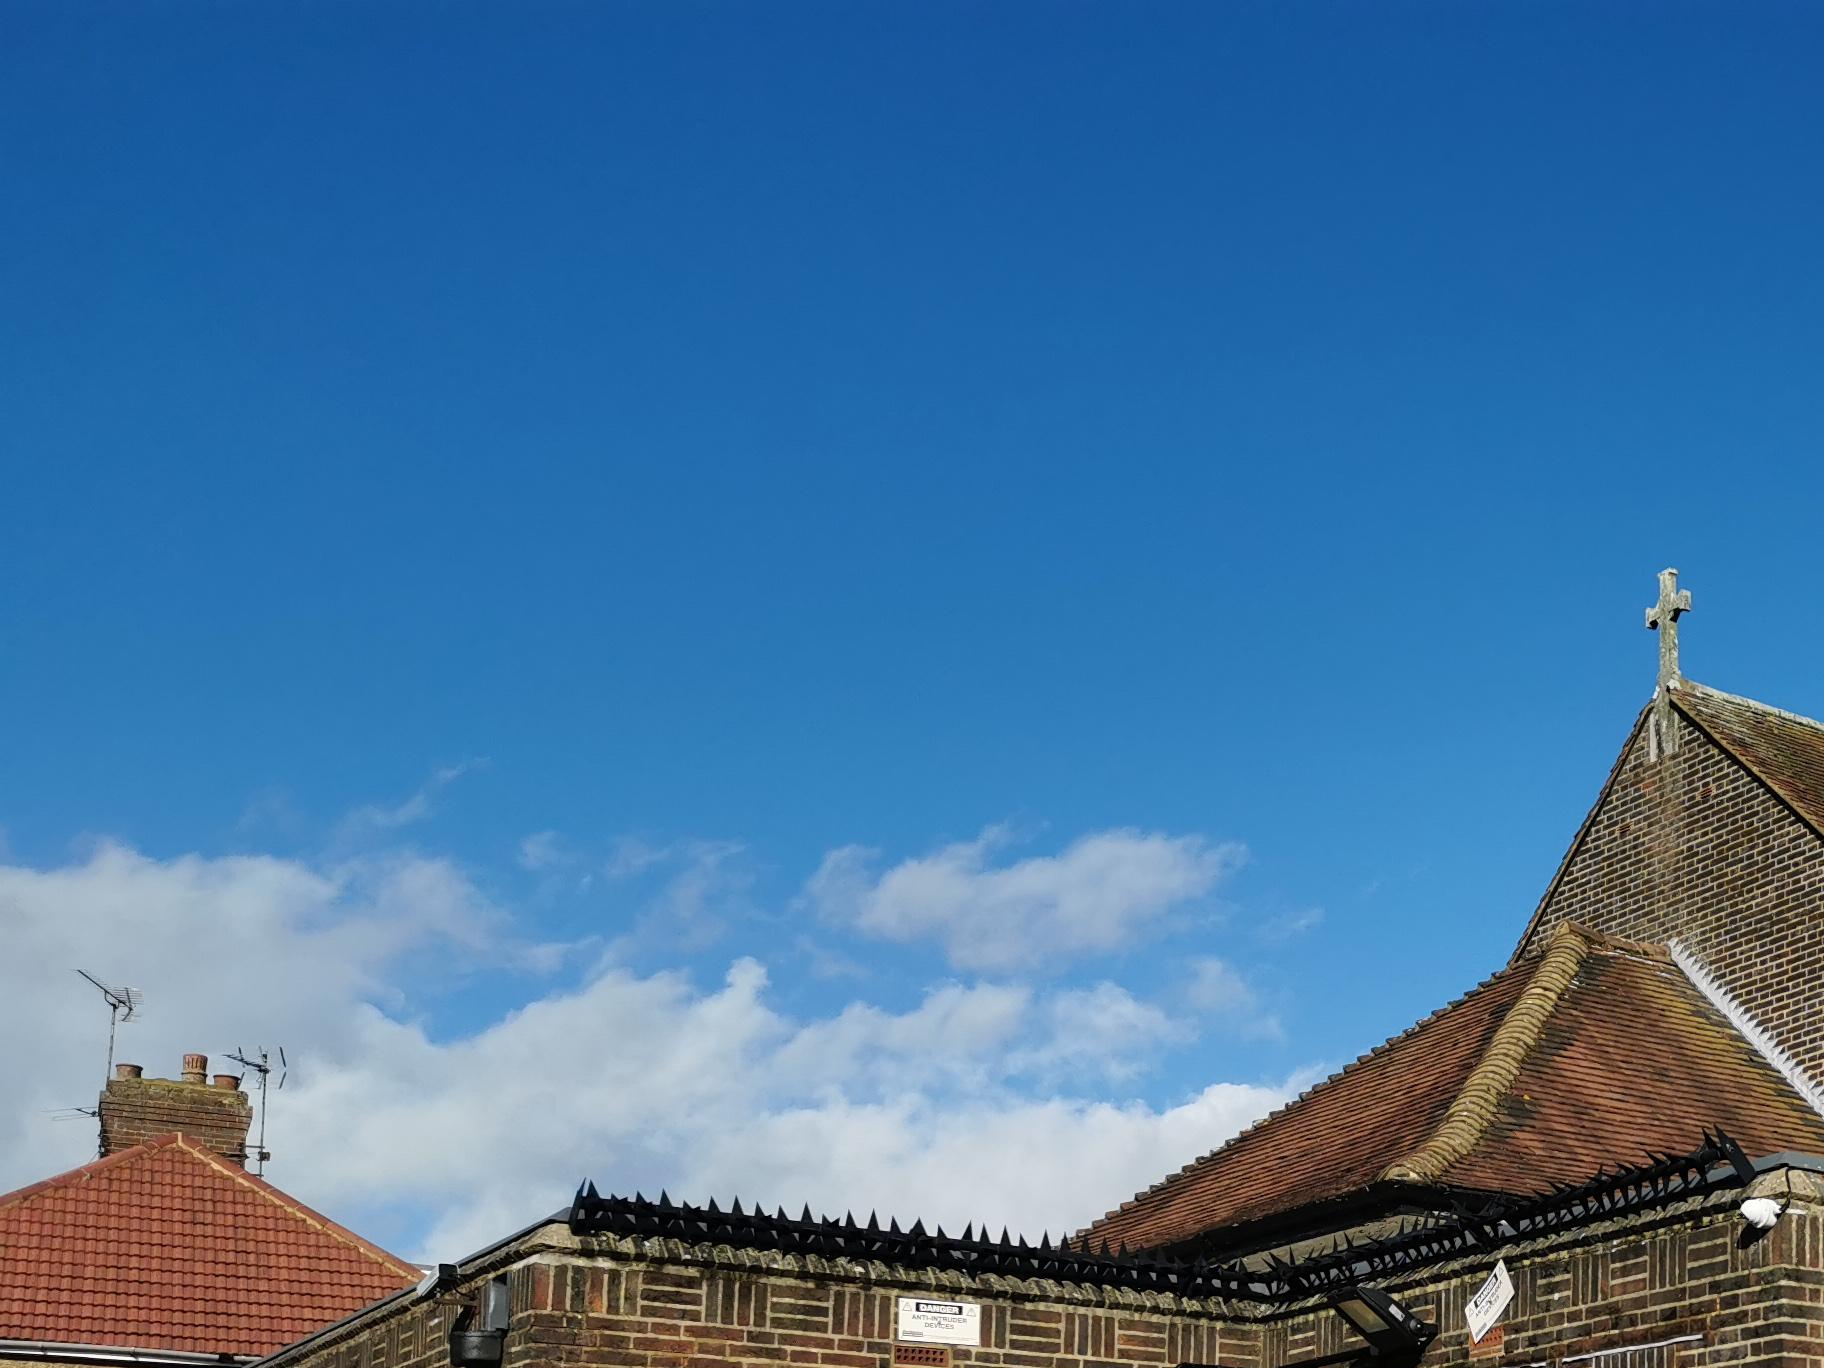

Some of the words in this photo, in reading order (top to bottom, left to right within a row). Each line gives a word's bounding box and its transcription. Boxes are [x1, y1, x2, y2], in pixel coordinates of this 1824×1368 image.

[919, 1304, 960, 1315] DANGER
[912, 1314, 968, 1324] ANTI-INTRUDER
[924, 1322, 955, 1330] DEVICES
